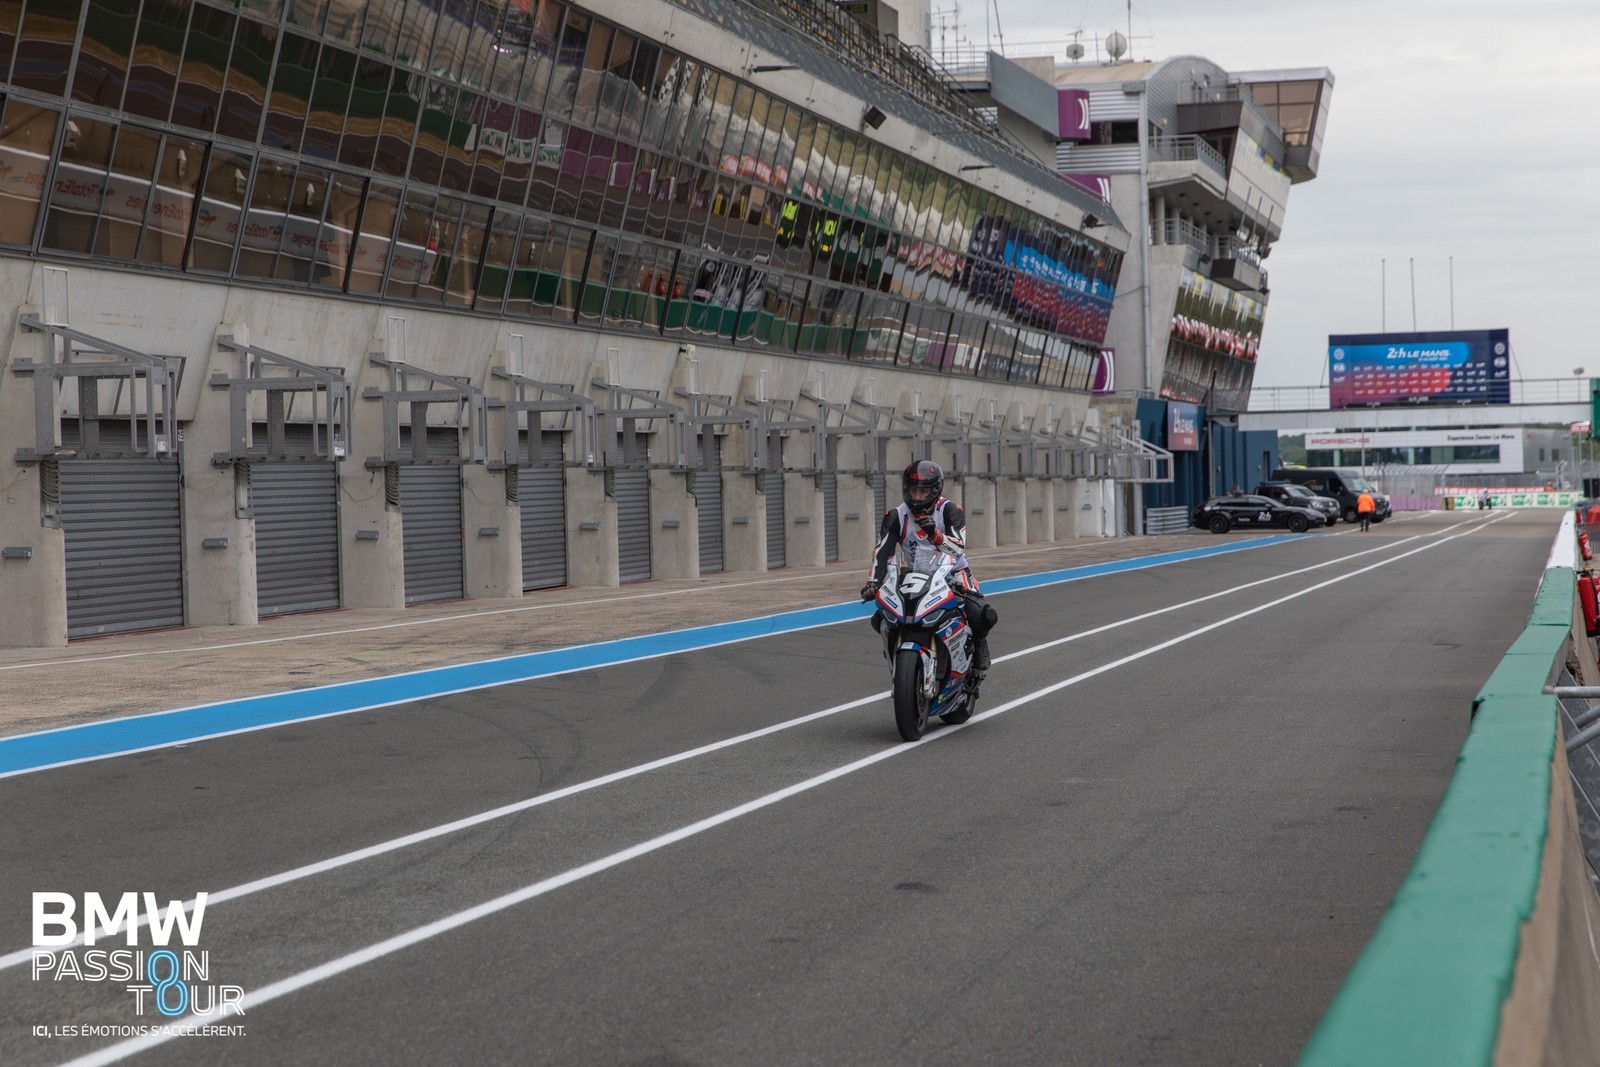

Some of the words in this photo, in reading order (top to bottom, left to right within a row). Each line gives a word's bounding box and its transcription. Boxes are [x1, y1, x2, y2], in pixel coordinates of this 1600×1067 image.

[1407, 350, 1419, 358] LE
[1421, 349, 1450, 357] MANS
[1447, 434, 1474, 442] Experience
[899, 572, 930, 594] 5
